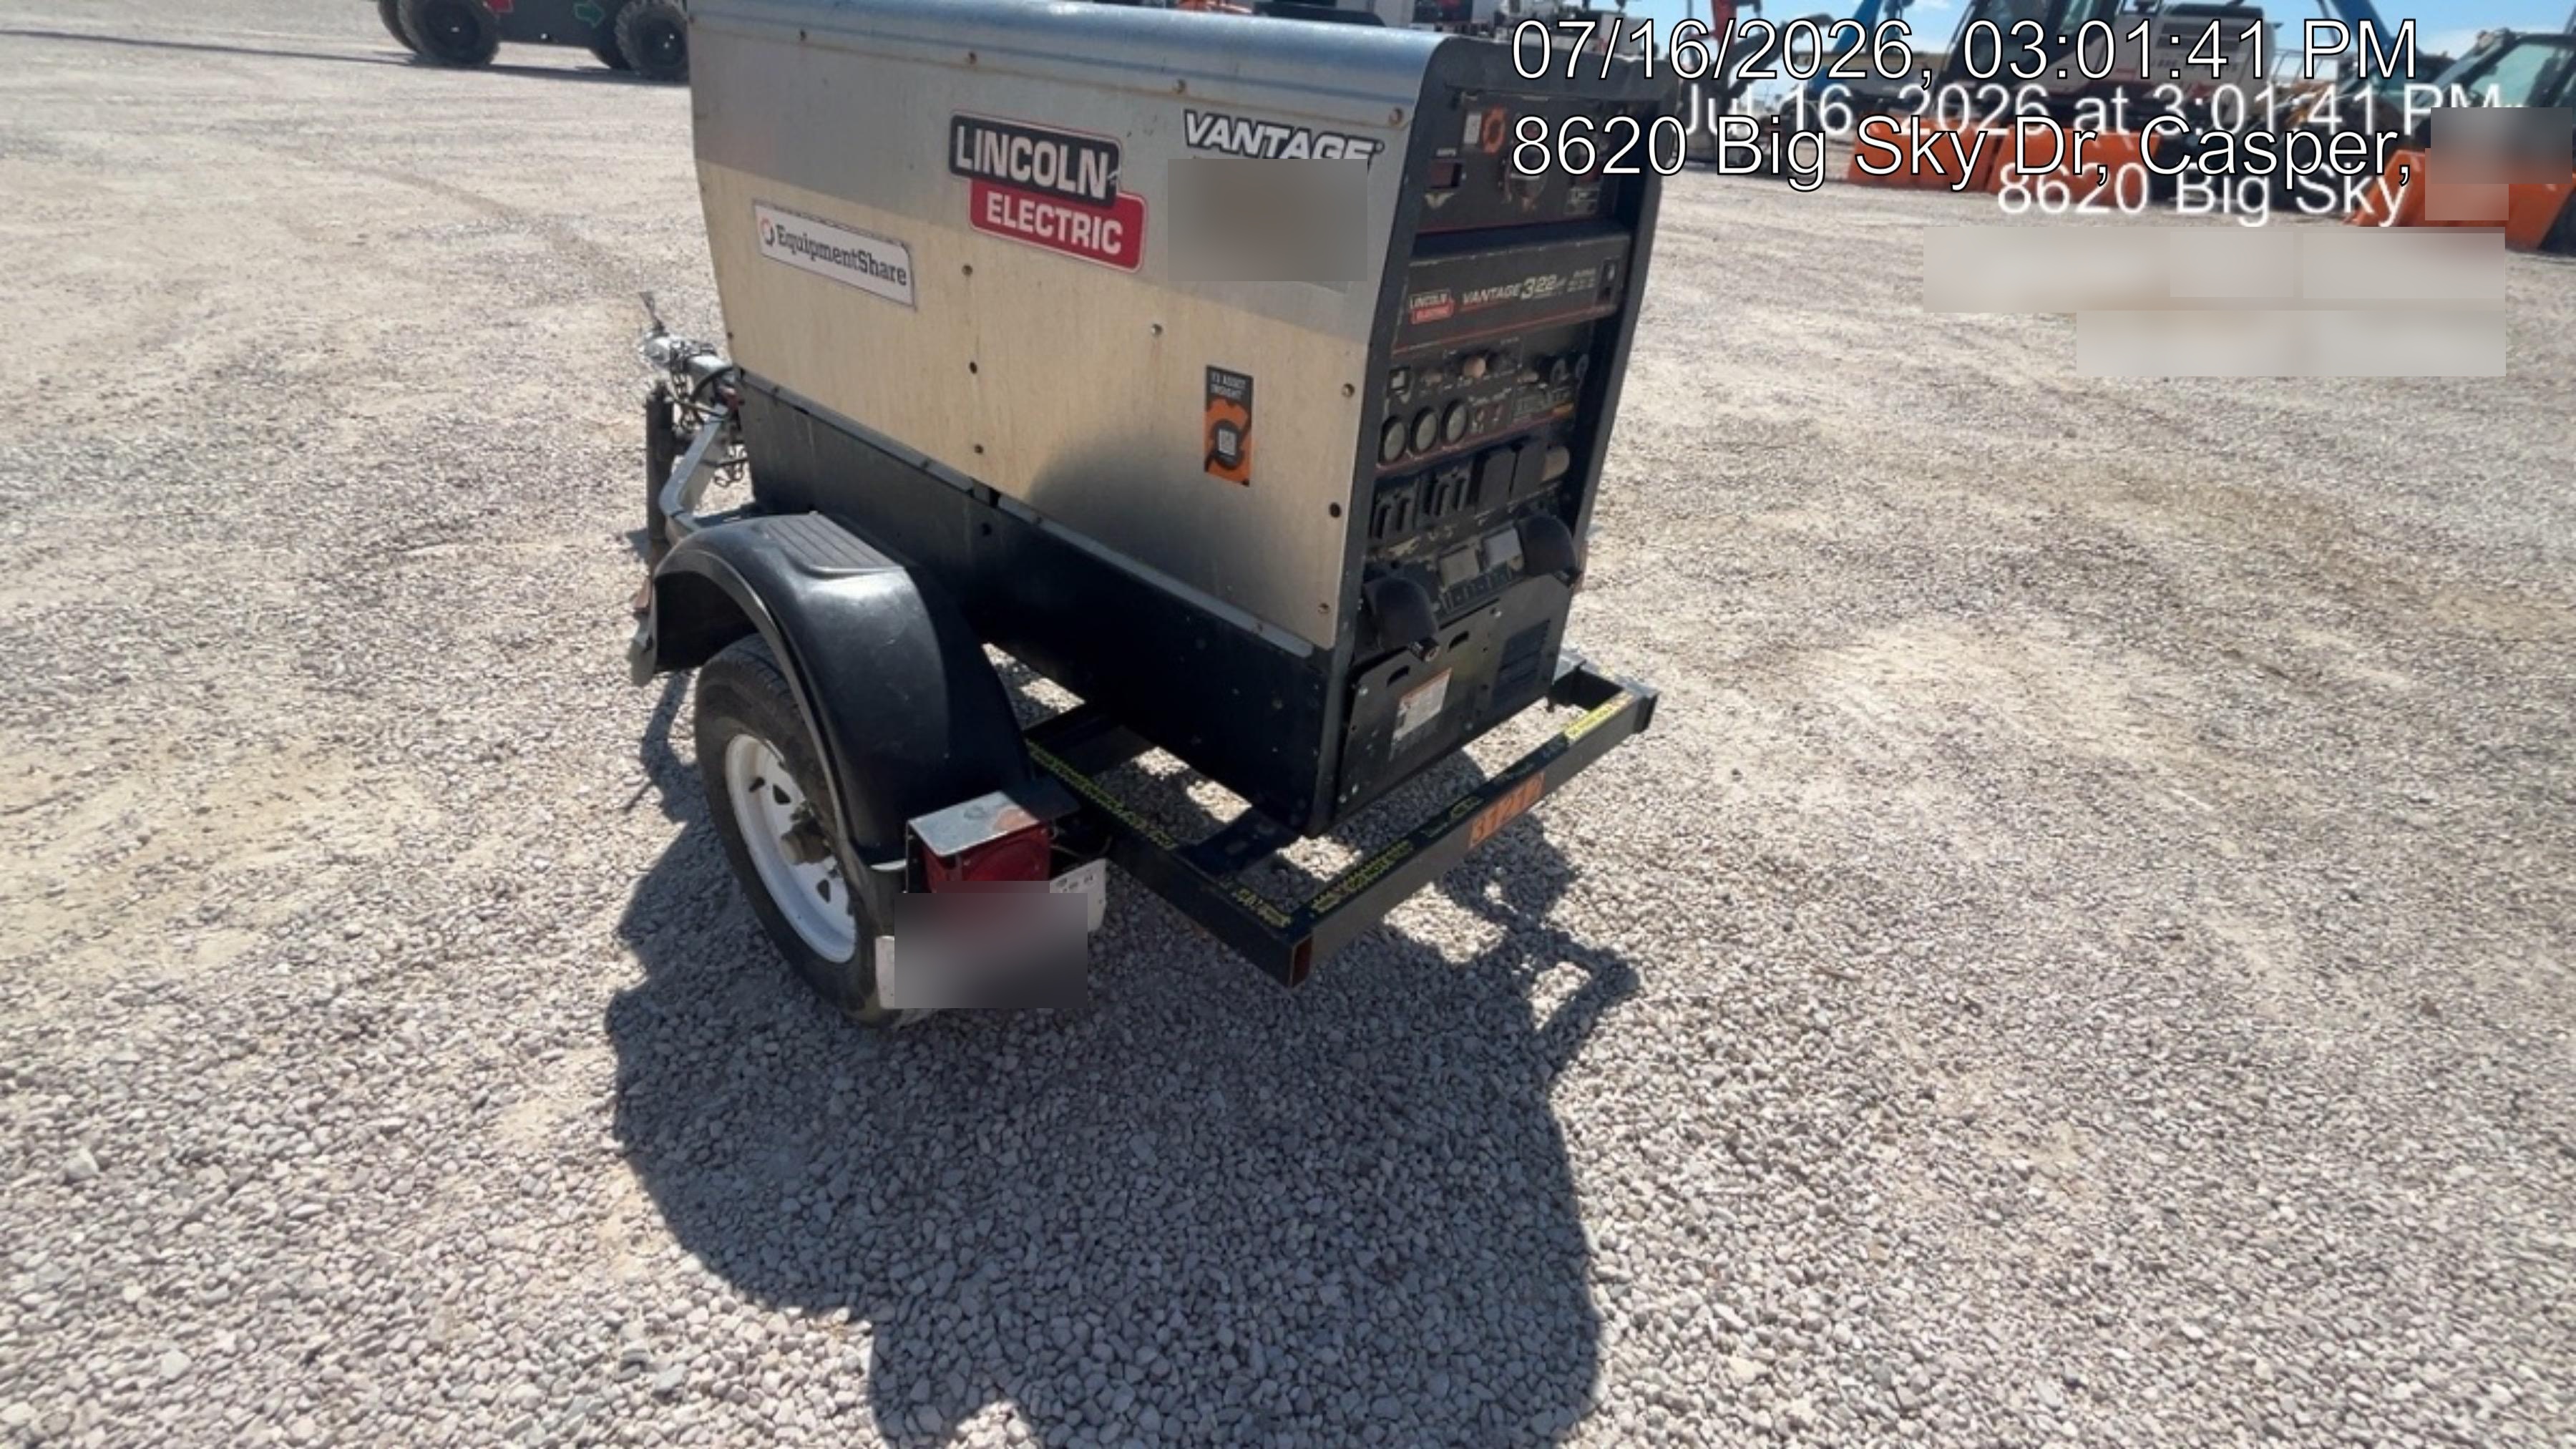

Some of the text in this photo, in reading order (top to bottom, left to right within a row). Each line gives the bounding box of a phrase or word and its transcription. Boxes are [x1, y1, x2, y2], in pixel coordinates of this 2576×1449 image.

[955, 125, 1110, 200] LINCOLN
[776, 224, 907, 286] EquipmentShare
[986, 190, 1124, 255] ELECTRIC
